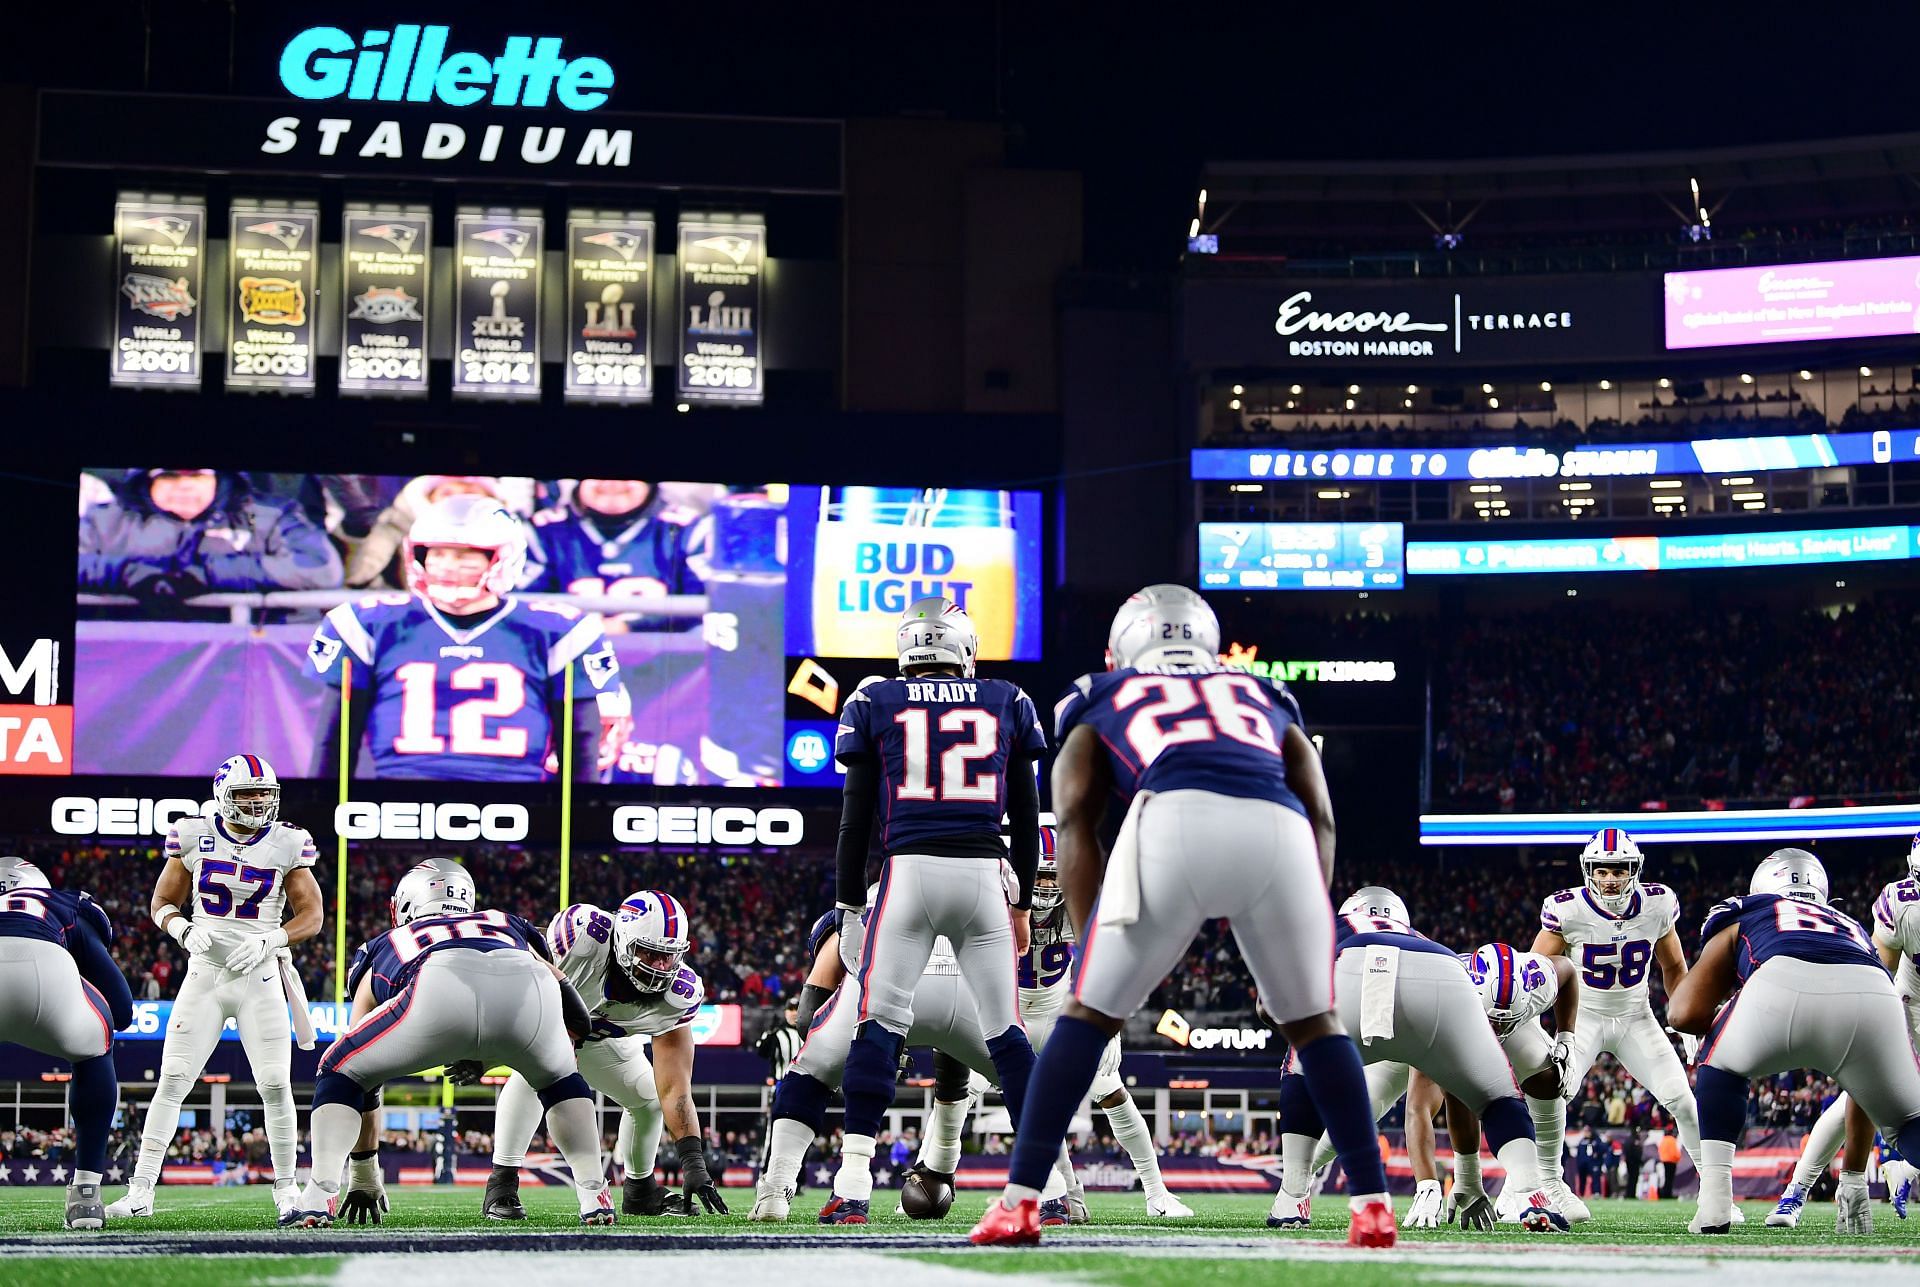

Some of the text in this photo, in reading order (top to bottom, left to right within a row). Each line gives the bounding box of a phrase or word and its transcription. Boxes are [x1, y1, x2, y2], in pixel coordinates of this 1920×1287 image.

[280, 25, 614, 111] Gillette
[262, 117, 633, 166] STADIUM
[1275, 291, 1448, 335] Encore
[1468, 312, 1571, 330] TERRACE
[1290, 341, 1433, 355] BOSTON HARBOR
[122, 350, 190, 372] 2001
[234, 354, 306, 375] 2003
[348, 358, 421, 380] 2004
[464, 362, 530, 383] 2014
[577, 364, 642, 386] 2016
[1249, 454, 1394, 476] WELCOME
[1410, 454, 1447, 476] TO
[855, 543, 955, 576] BUD
[1220, 546, 1239, 569] 7
[1365, 544, 1384, 568] 3
[838, 580, 973, 613] LIGHT
[914, 633, 933, 647] 12
[1162, 623, 1192, 639] 26
[909, 654, 936, 662] PATRIOTS
[1250, 661, 1396, 681] RAFTKINGS
[906, 682, 977, 703] BRADY
[393, 662, 529, 758] 12
[1112, 672, 1283, 768] 26
[893, 707, 1000, 802] 12
[51, 797, 217, 836] GEIC
[334, 801, 529, 842] GEICO
[612, 806, 804, 845] GEICO
[198, 858, 277, 920] 57
[1791, 873, 1811, 885] 61
[446, 885, 467, 900] 62
[442, 904, 469, 914] PATRIOTS
[1370, 907, 1391, 918] 69
[1583, 939, 1651, 990] 58
[1189, 1028, 1266, 1049] OPTUM
